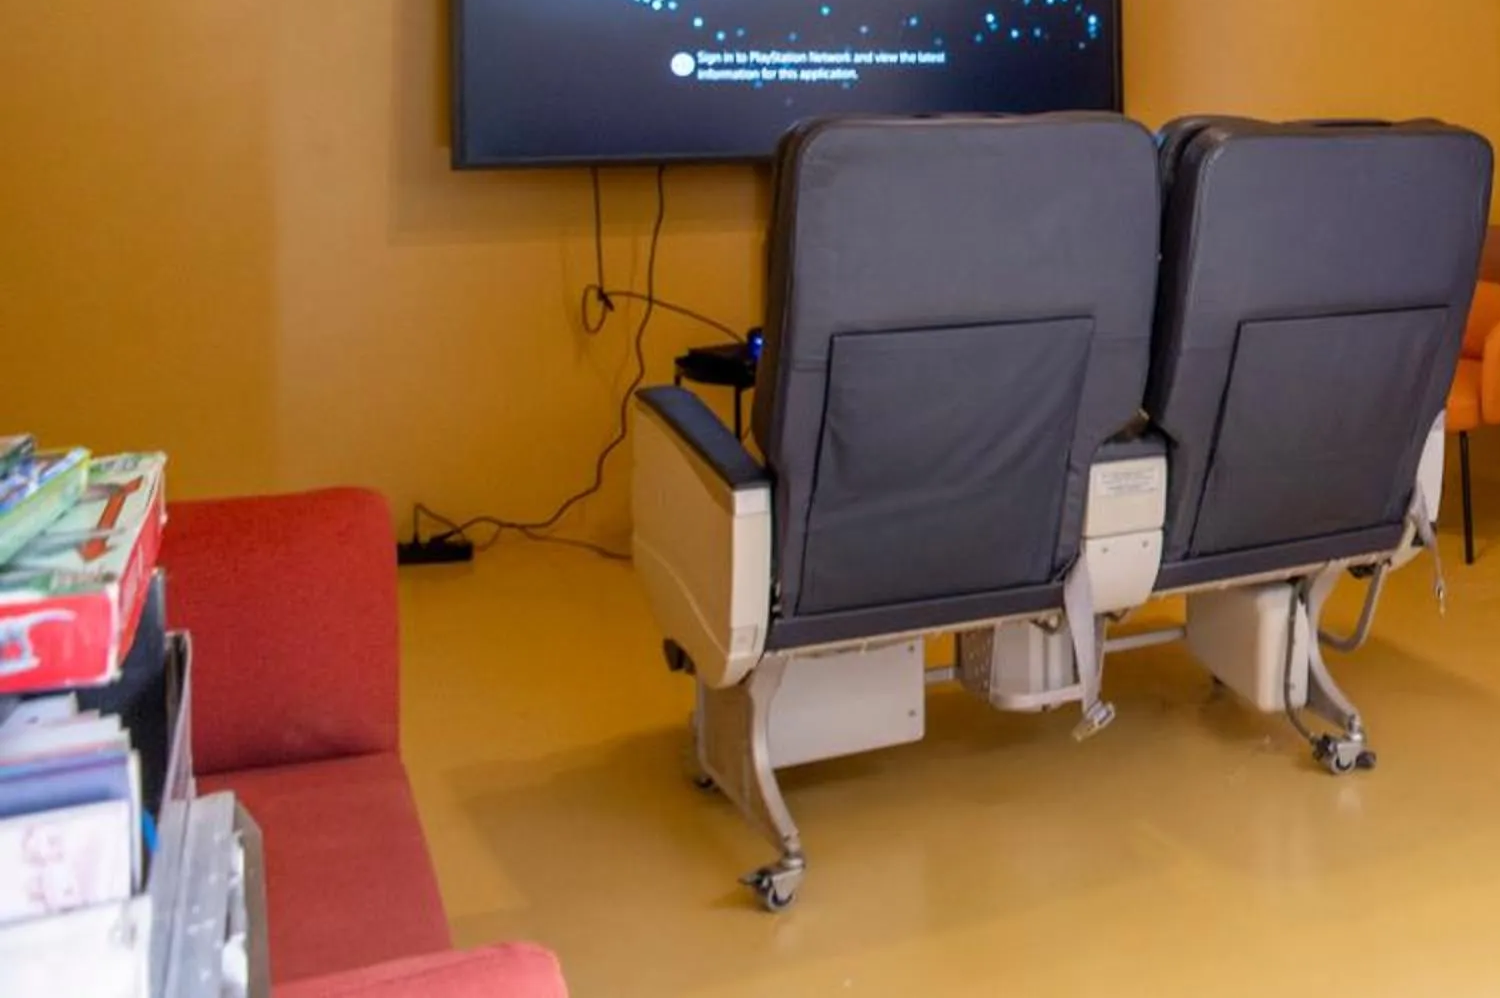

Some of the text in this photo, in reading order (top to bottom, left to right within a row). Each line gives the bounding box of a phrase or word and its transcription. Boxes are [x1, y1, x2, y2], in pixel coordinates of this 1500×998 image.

[697, 51, 722, 66] Sign
[749, 51, 807, 66] PlayStation
[809, 51, 851, 64] Network
[854, 51, 873, 64] and
[899, 51, 916, 64] the
[697, 68, 760, 81] information
[761, 68, 777, 81] for
